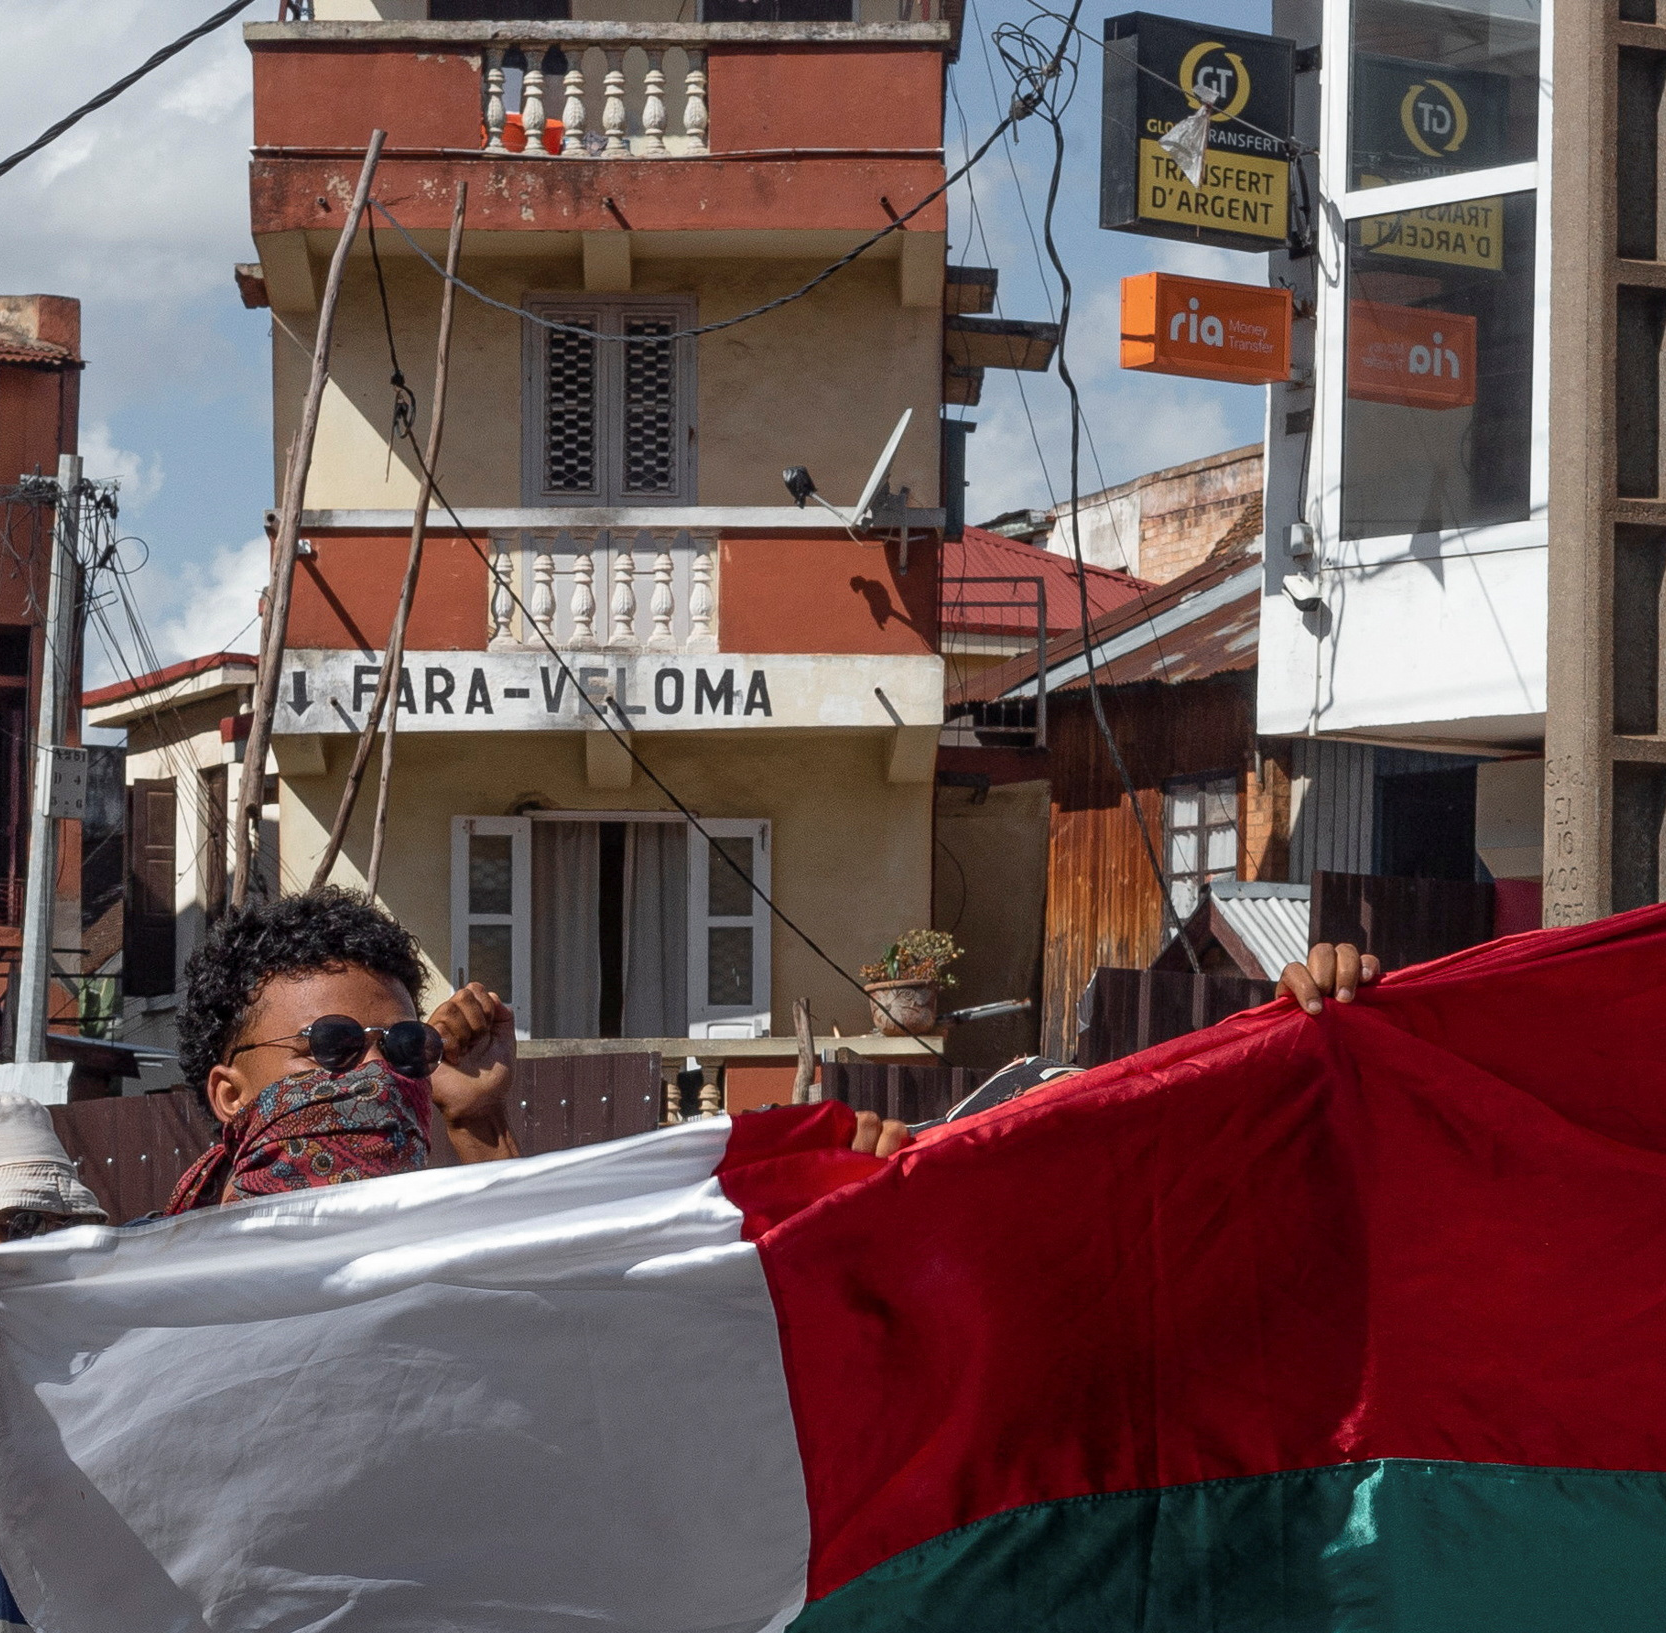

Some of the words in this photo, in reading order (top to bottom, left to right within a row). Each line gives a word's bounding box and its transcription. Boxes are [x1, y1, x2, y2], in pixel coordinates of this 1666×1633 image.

[1197, 66, 1232, 98] GT
[1208, 129, 1280, 153] RANSFERT
[1151, 155, 1275, 196] TRSFERT
[1151, 185, 1274, 225] D'ARGENT
[1170, 297, 1224, 347] ria
[1228, 320, 1268, 339] Money
[1228, 335, 1274, 353] Transfer
[353, 665, 772, 718] FARA-VELOMA
